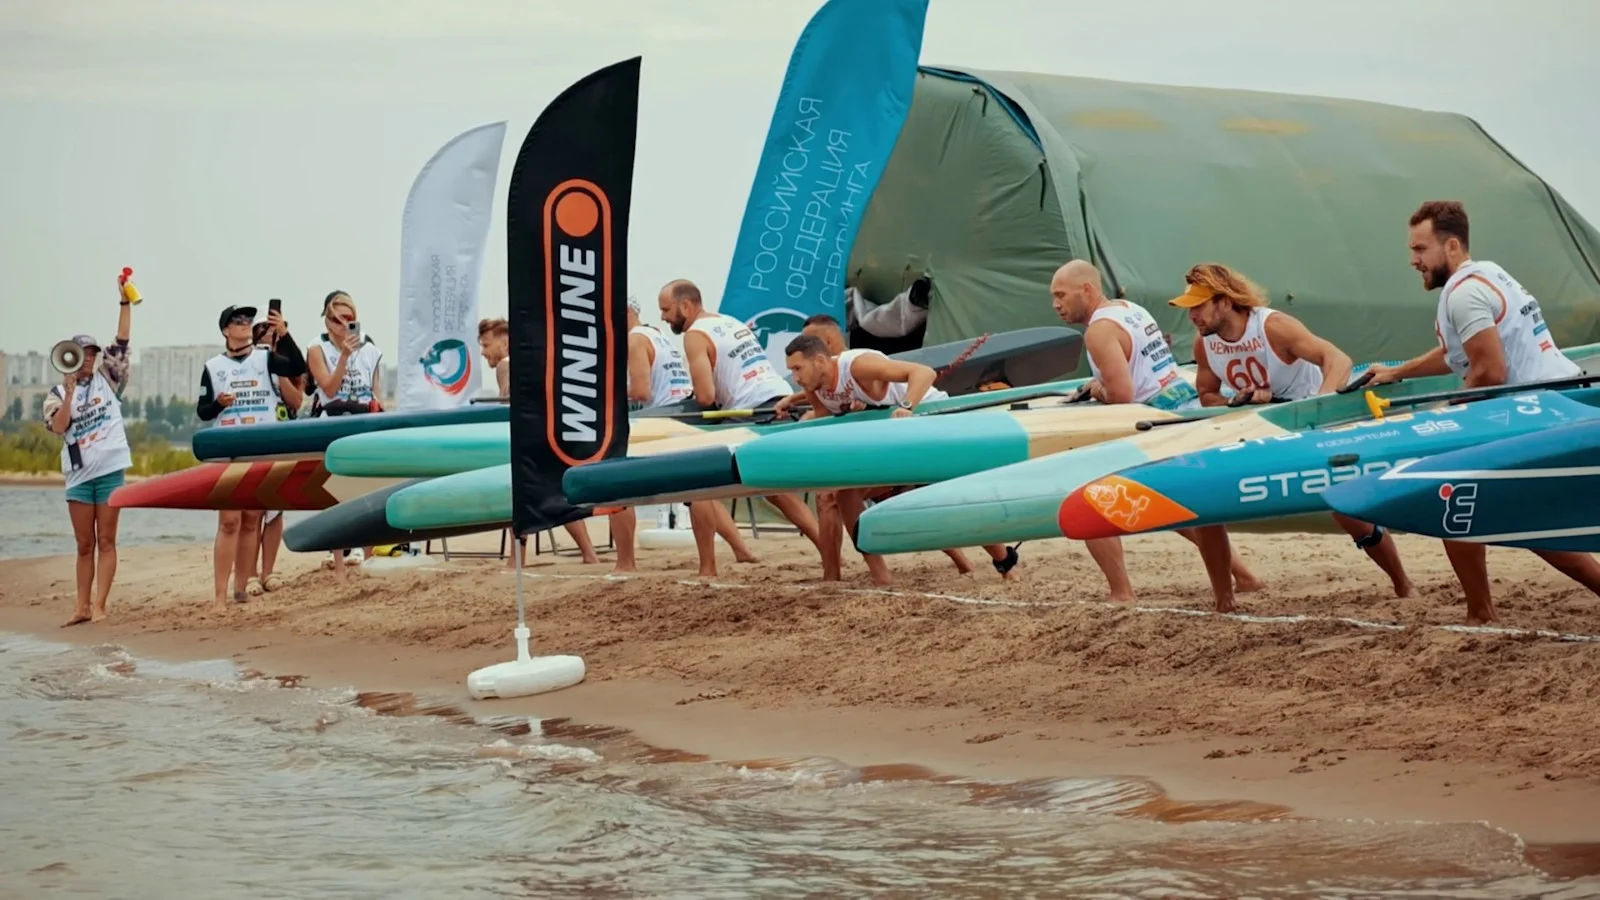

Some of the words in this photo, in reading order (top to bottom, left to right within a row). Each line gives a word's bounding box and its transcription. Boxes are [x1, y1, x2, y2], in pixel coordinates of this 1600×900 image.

[748, 97, 824, 291] РОССИЙСКАЯ
[785, 129, 852, 298] ФЕДЕРАЦИЯ
[560, 244, 598, 443] WINLINE
[1226, 356, 1269, 391] 60
